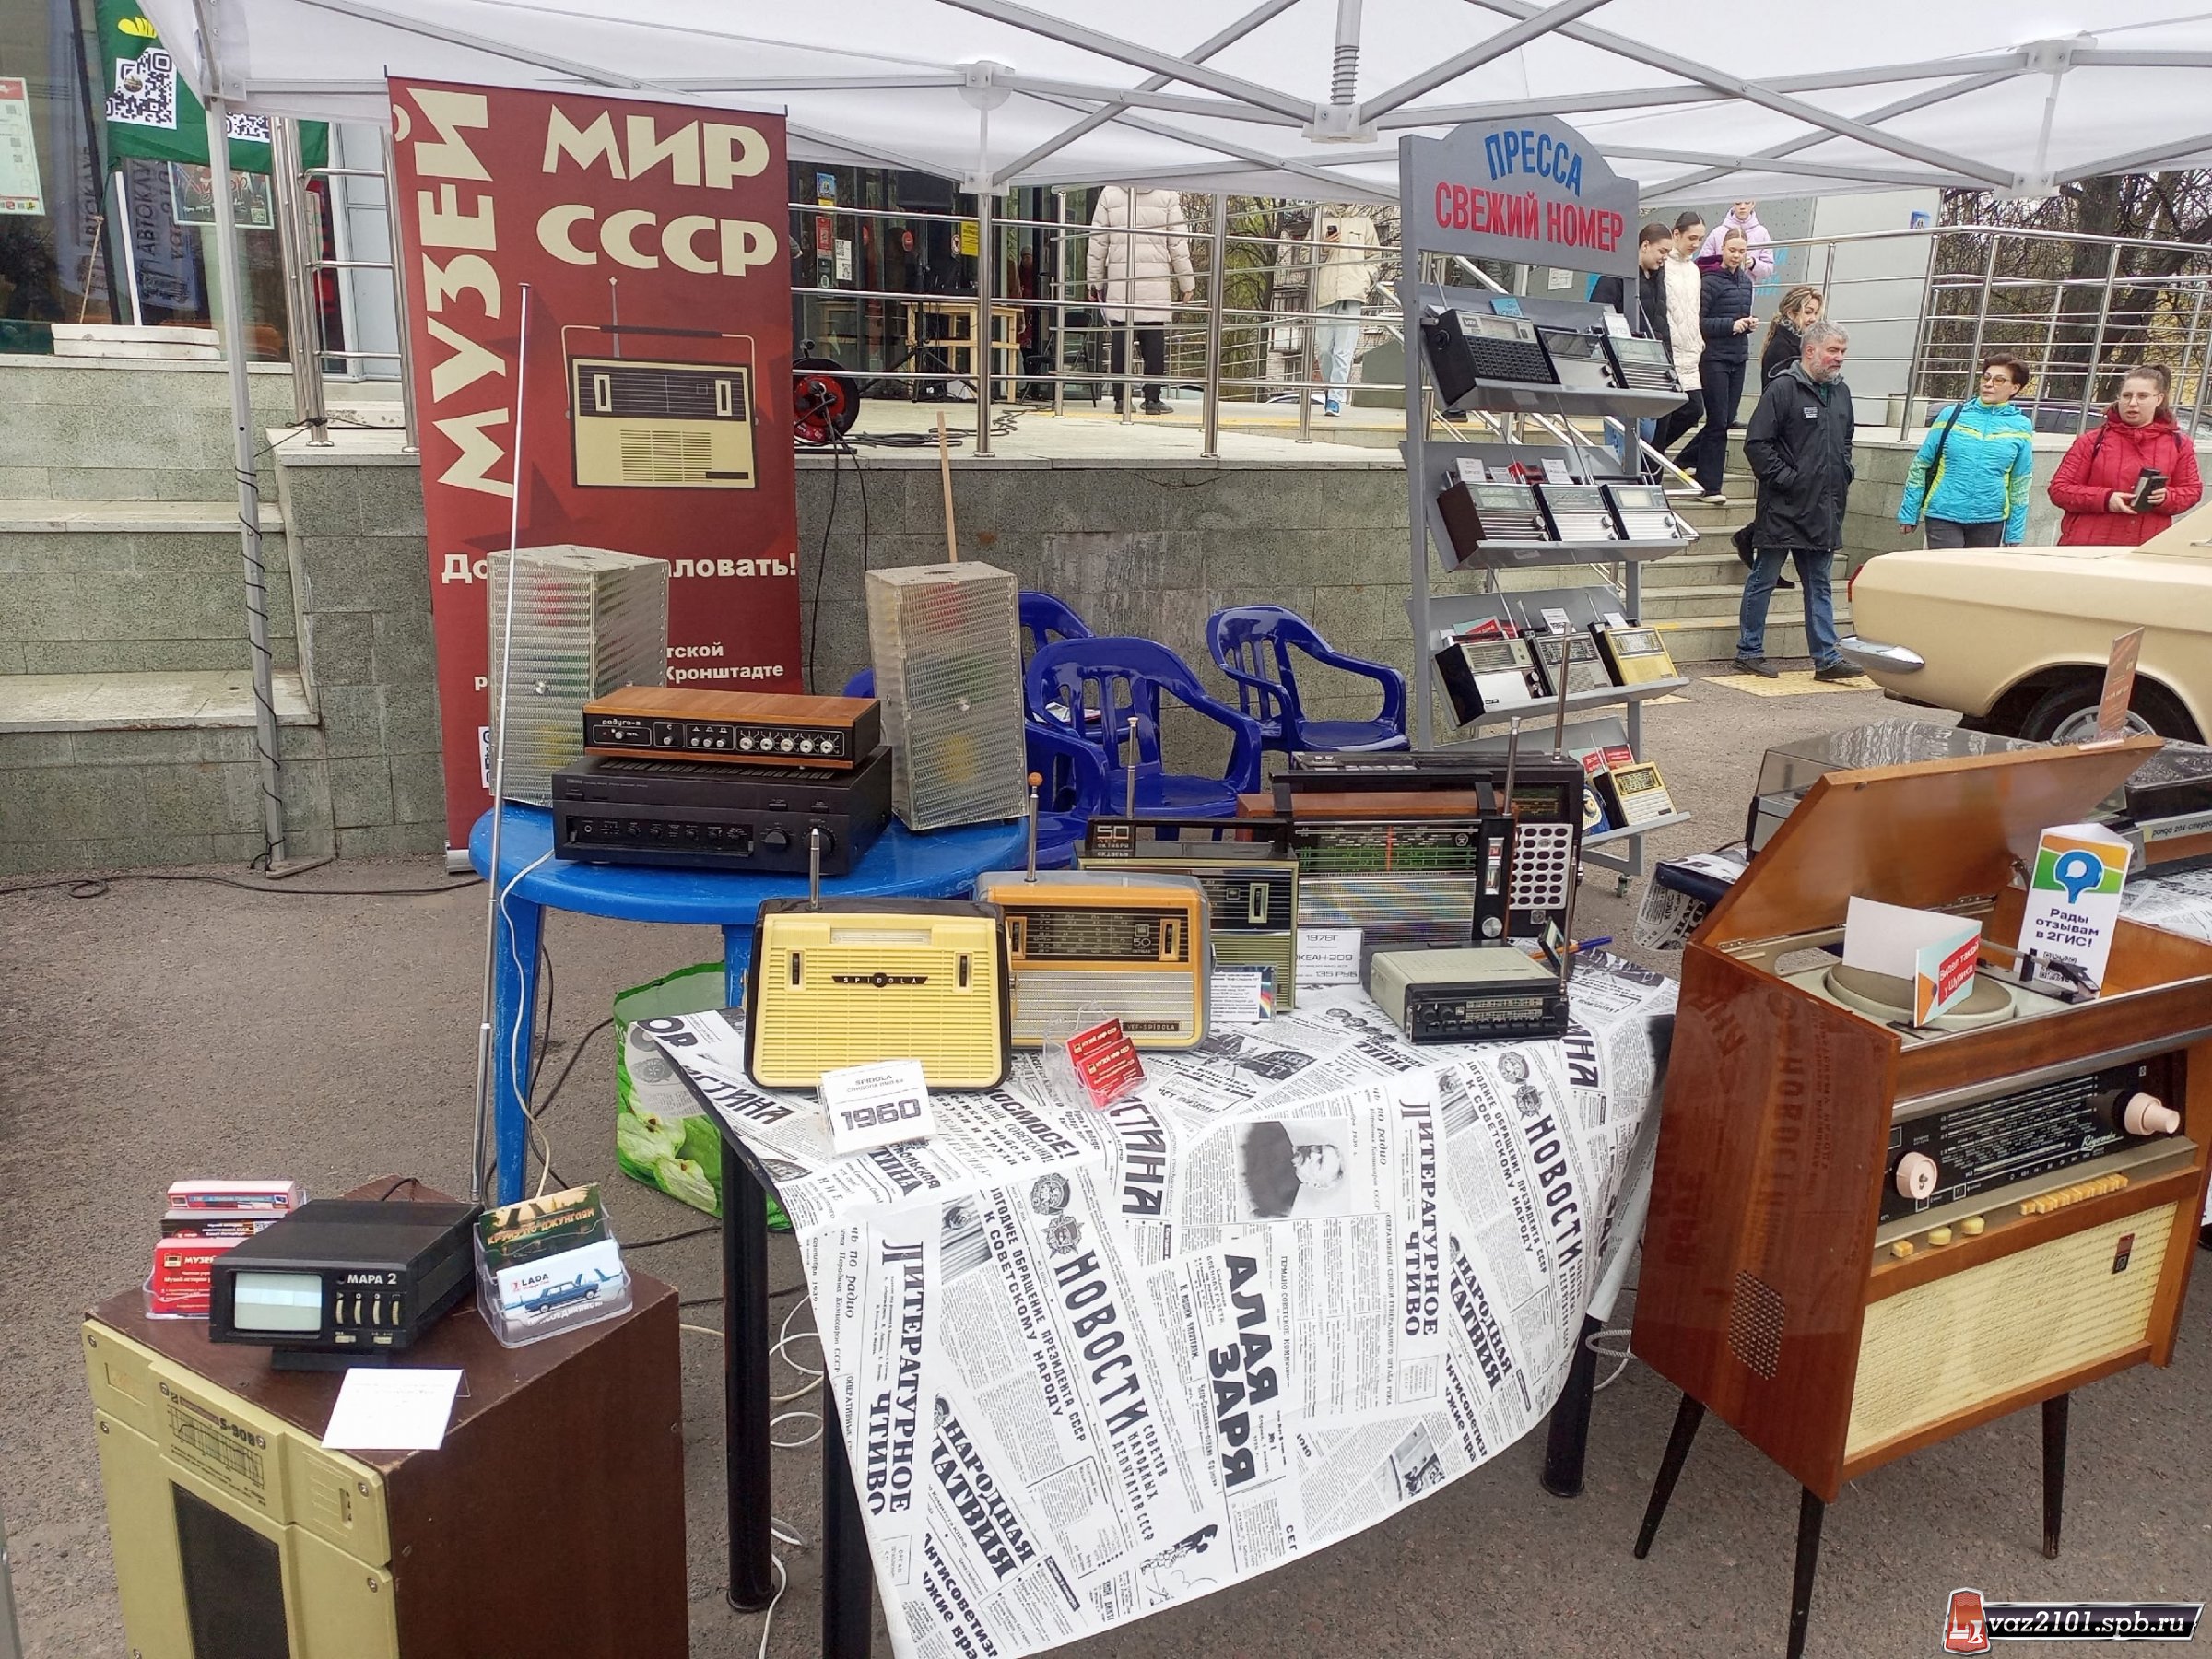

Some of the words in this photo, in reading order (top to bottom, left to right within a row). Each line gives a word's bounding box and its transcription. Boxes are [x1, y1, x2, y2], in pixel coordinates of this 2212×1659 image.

[542, 103, 770, 190] МИР
[1484, 129, 1583, 198] ПРЕССА
[132, 159, 158, 256] АВТОКЛУ
[536, 203, 778, 276] СССР
[1435, 181, 1541, 241] СВЕЖИЙ
[1547, 200, 1624, 253] НОМЕР
[392, 87, 514, 499] МУЗЕЙ
[2035, 918, 2100, 937] отзывам
[2036, 932, 2045, 941] в
[2046, 930, 2093, 948] 2ГИС!
[2050, 908, 2089, 924] Рады
[842, 975, 918, 986] SPIDOLA
[841, 1097, 922, 1132] 1960
[1465, 1079, 1475, 1090] К
[1473, 1095, 1516, 1189] СОВЕТСКОМУ
[1512, 1196, 1534, 1253] НАРОДУ
[1494, 1112, 1521, 1175] ОБРАЩЕНИЕ
[1517, 1180, 1542, 1244] ПРЕЗИДЕНТА
[1524, 1113, 1583, 1268] НОВОСТИ
[1398, 1099, 1440, 1336] ЛИТЕРАТУРНОЕ
[347, 1273, 383, 1285] МАРА
[387, 1272, 397, 1285] 2
[521, 1272, 550, 1288] LADA
[983, 1210, 996, 1224] К
[990, 1229, 1037, 1341] СОВЕТСКОМУ
[1033, 1350, 1064, 1417] НАРОДУ
[1404, 1231, 1423, 1336] ЧТИВО
[1455, 1253, 1512, 1378] НАРОДНАЯ
[882, 1239, 925, 1513] ЛИТЕРАТУРНОЕ
[1012, 1249, 1047, 1324] ОБРАЩЕНИЕ
[1041, 1329, 1075, 1407] ПРЕЗИДЕНТА
[1068, 1411, 1088, 1441] СССР
[1053, 1248, 1150, 1439] НОВОСТИ
[1224, 1253, 1279, 1406] АЛАЯ
[865, 1389, 892, 1516] ЧТИВО
[1142, 1423, 1169, 1477] СОВЕТОВ
[1208, 1341, 1256, 1488] ЗАРЯ
[943, 1416, 1037, 1564] НАРОДНАЯ
[1112, 1441, 1143, 1508] ДЕПУТАТОВ
[1126, 1431, 1159, 1500] НАРОДНЫХ
